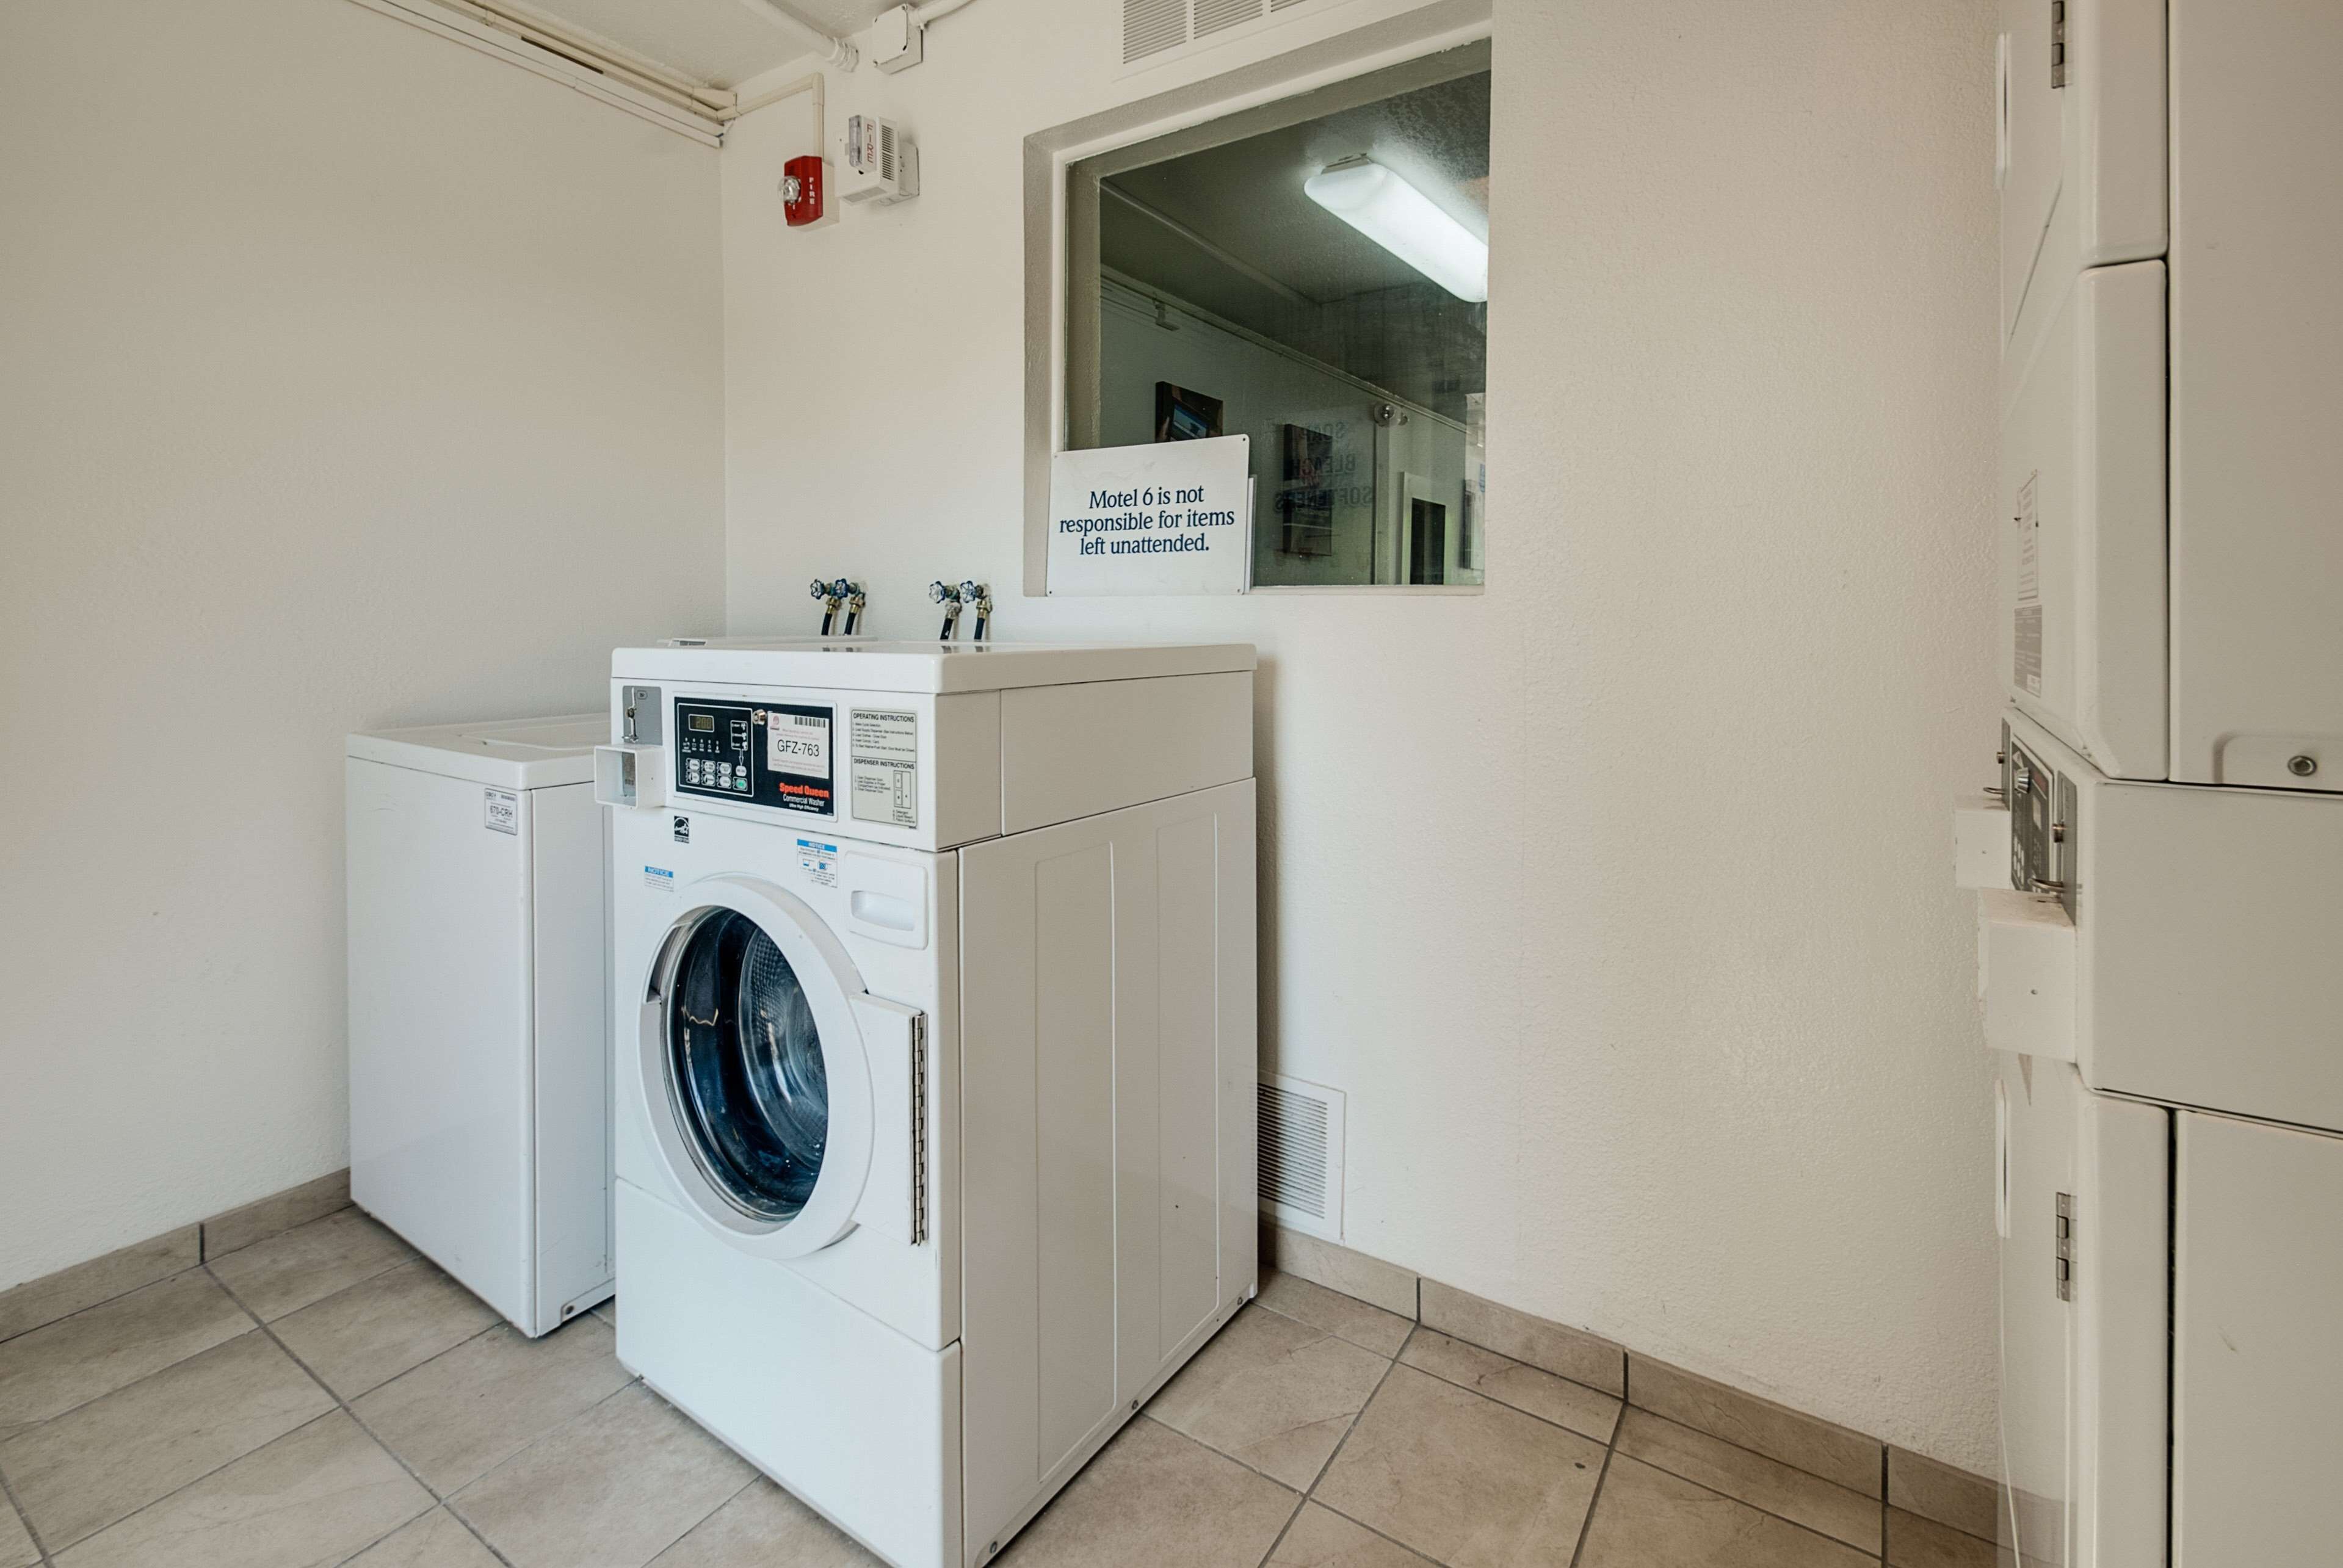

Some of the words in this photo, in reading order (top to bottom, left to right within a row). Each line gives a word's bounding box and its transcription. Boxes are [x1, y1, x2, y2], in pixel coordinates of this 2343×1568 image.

[1089, 489, 1138, 508] Motel
[1143, 487, 1153, 505] 6
[1157, 486, 1171, 505] is
[1175, 485, 1204, 504] not
[1060, 511, 1153, 537] responsible
[1158, 510, 1182, 529] for
[1186, 509, 1235, 527] items
[1079, 537, 1106, 555] left
[1110, 533, 1209, 554] unattended.
[880, 714, 914, 723] INSTRUCTIONS
[777, 739, 819, 757] GFZ-763
[779, 782, 803, 794] Speed
[804, 785, 829, 798] Queen
[783, 793, 808, 804] Commercial
[808, 798, 825, 806] Washer
